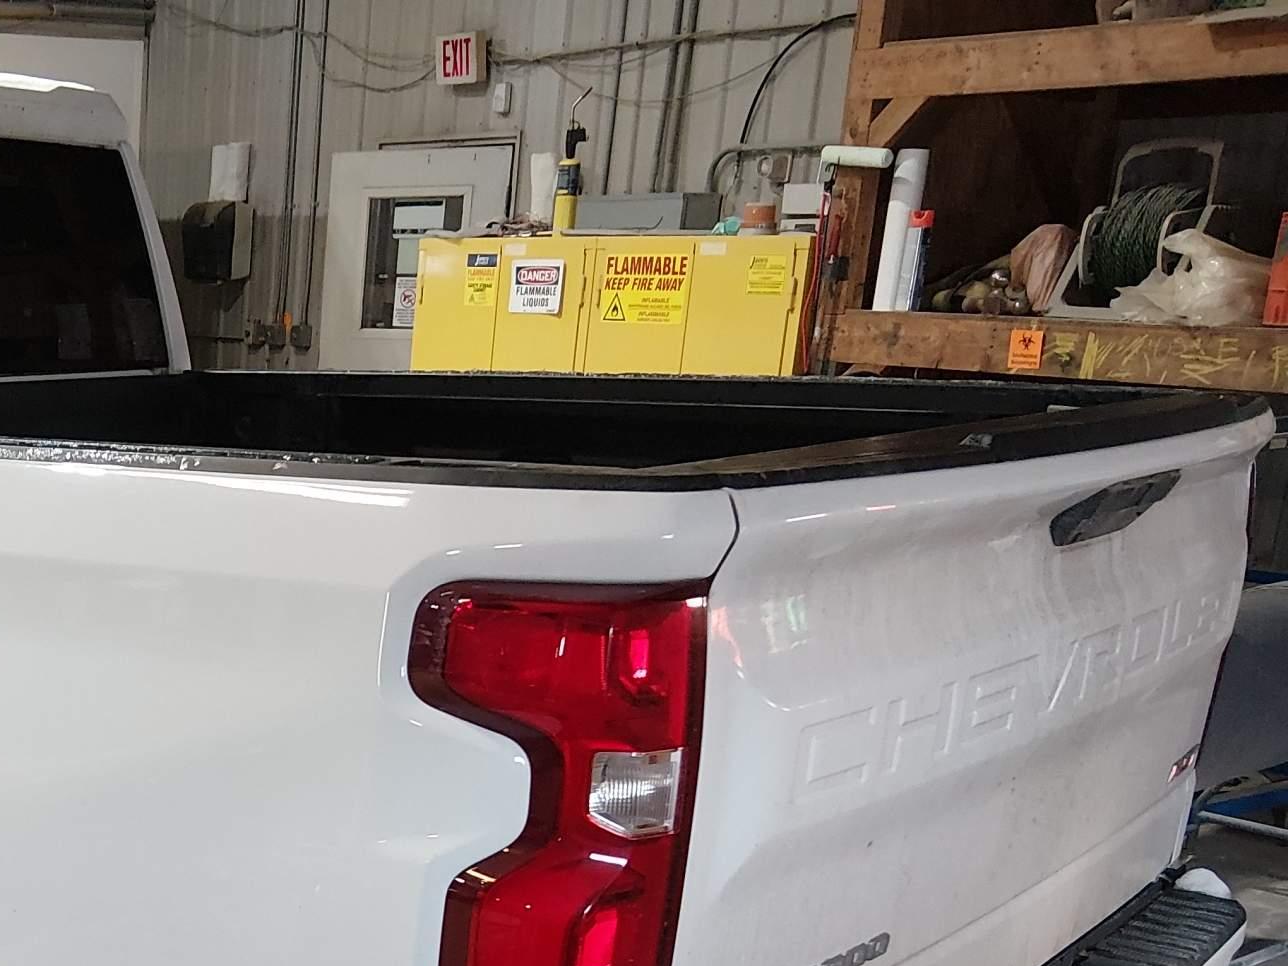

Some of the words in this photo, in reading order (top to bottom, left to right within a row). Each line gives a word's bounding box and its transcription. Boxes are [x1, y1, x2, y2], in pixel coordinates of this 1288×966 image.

[442, 37, 472, 78] EXIT
[606, 255, 689, 276] FLAMMABLE
[520, 270, 556, 281] DANGER
[516, 286, 557, 297] FLAMMABLE
[604, 277, 630, 291] KEEP
[631, 277, 654, 291] FIRE
[655, 278, 685, 292] AWAY
[522, 297, 550, 307] LIQUIDS
[796, 586, 1234, 794] CHEVROLE
